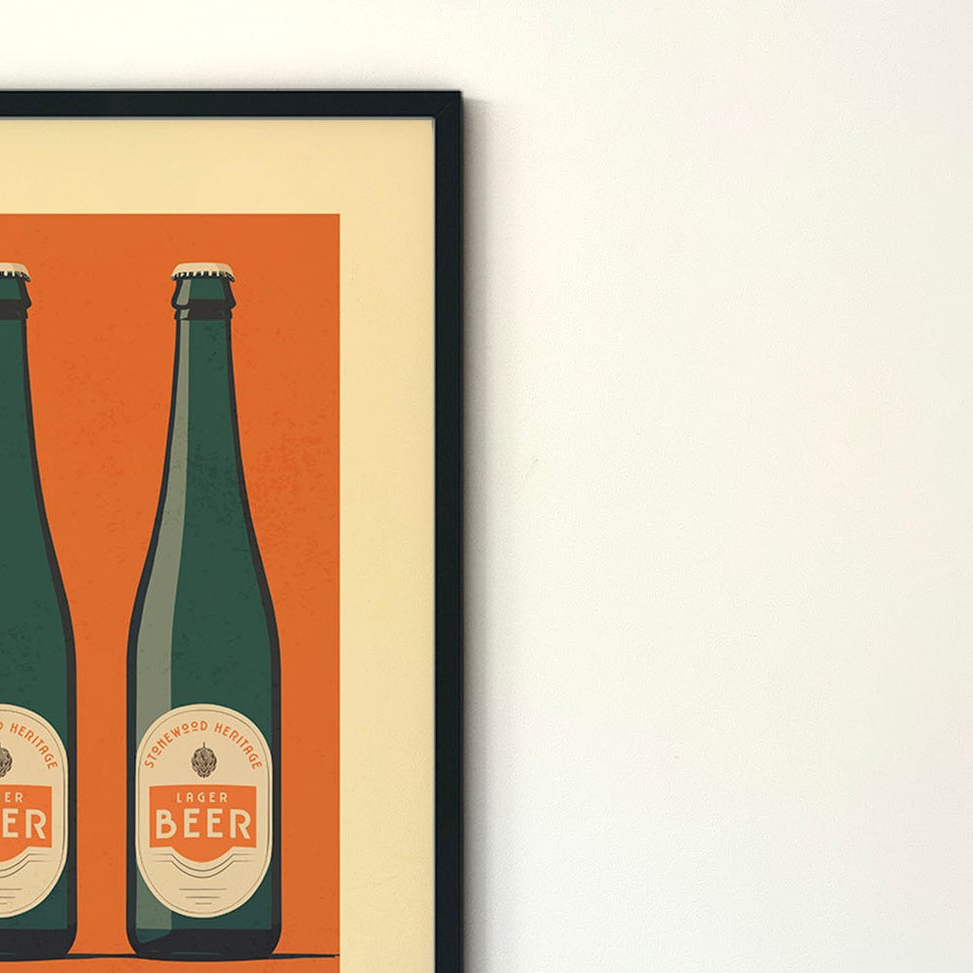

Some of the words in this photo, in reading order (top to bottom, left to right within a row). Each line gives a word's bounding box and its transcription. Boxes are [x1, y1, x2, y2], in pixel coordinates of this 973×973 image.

[10, 723, 58, 769] HERITAGE
[144, 721, 208, 768] STONEWOOD
[215, 723, 262, 769] HERITAGE
[177, 792, 227, 802] LAGER
[156, 808, 251, 839] BEER
